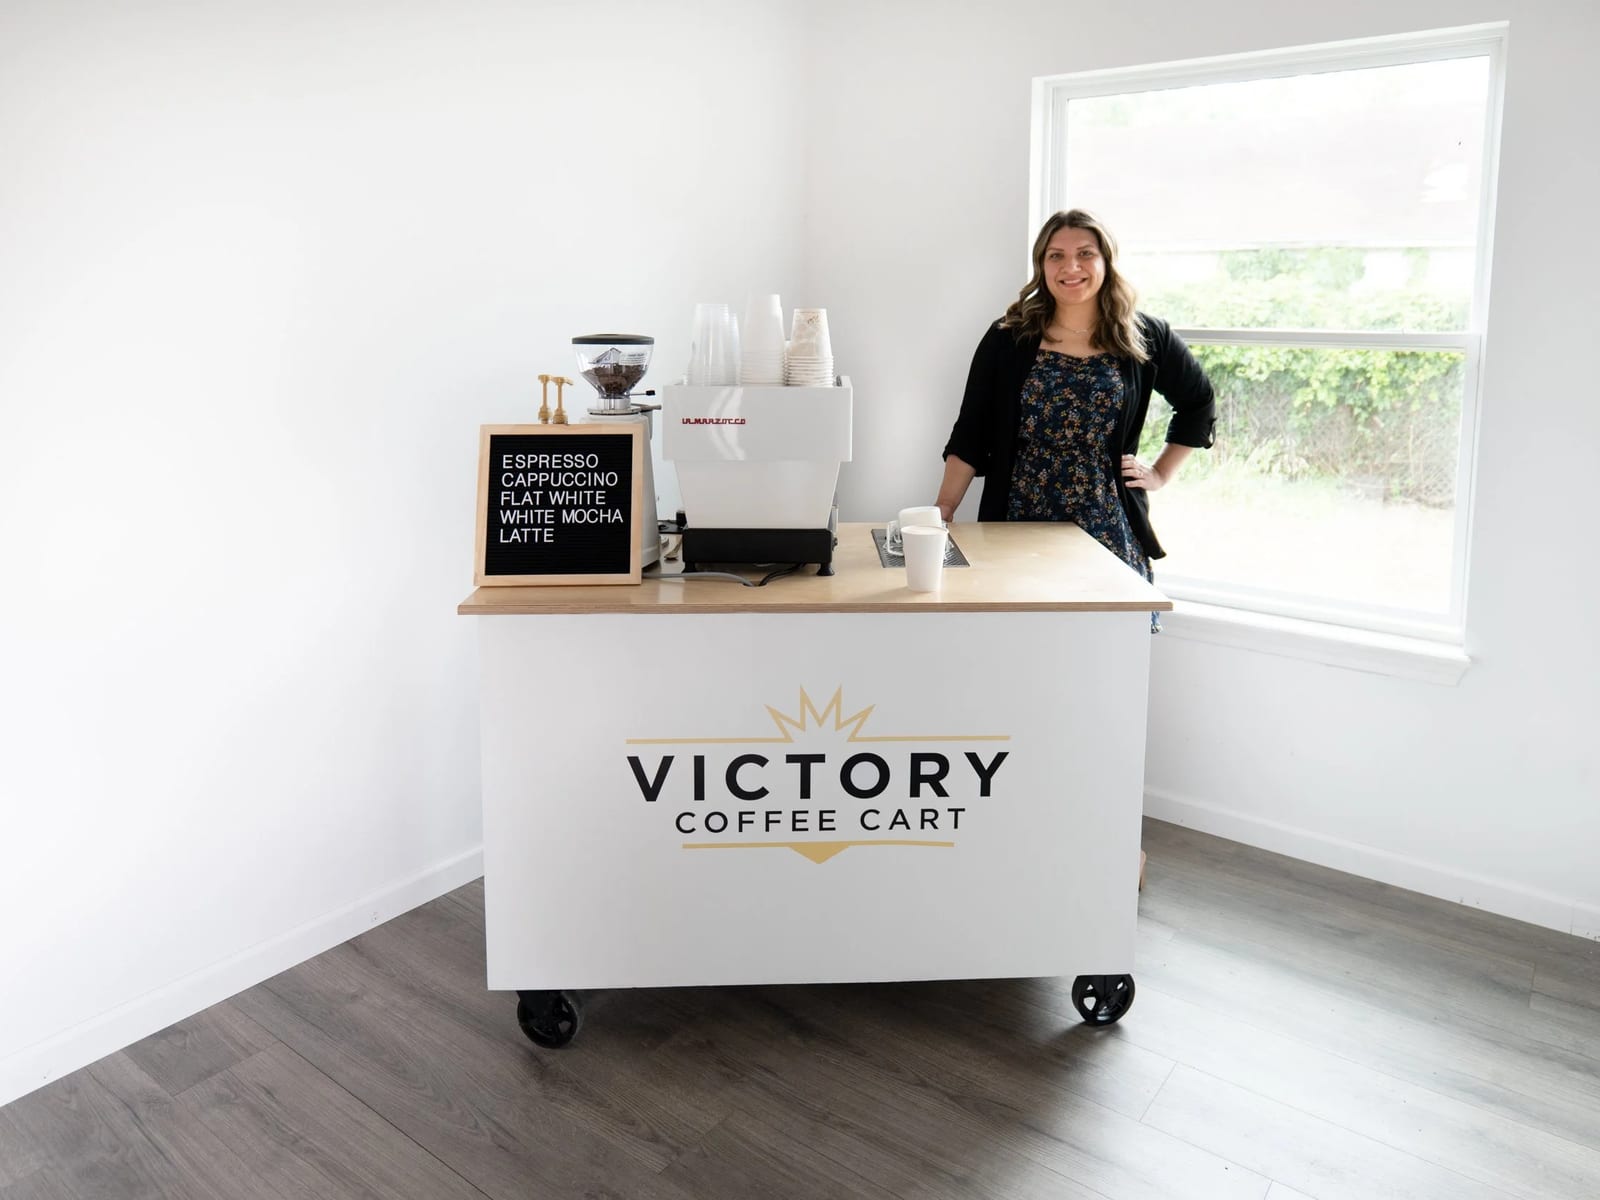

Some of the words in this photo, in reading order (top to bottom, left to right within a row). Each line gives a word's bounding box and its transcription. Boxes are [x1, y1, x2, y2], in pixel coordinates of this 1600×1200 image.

[502, 453, 599, 469] ESPRESSO
[501, 471, 618, 487] CAPPUCCINO
[500, 490, 544, 506] FLAT
[548, 490, 607, 505] WHITE
[499, 509, 555, 525] WHITE
[561, 508, 624, 524] MOCHA
[499, 527, 555, 544] LATTE
[626, 751, 1010, 802] VICTORY
[675, 809, 837, 834] COFFEE
[859, 807, 966, 832] CART
